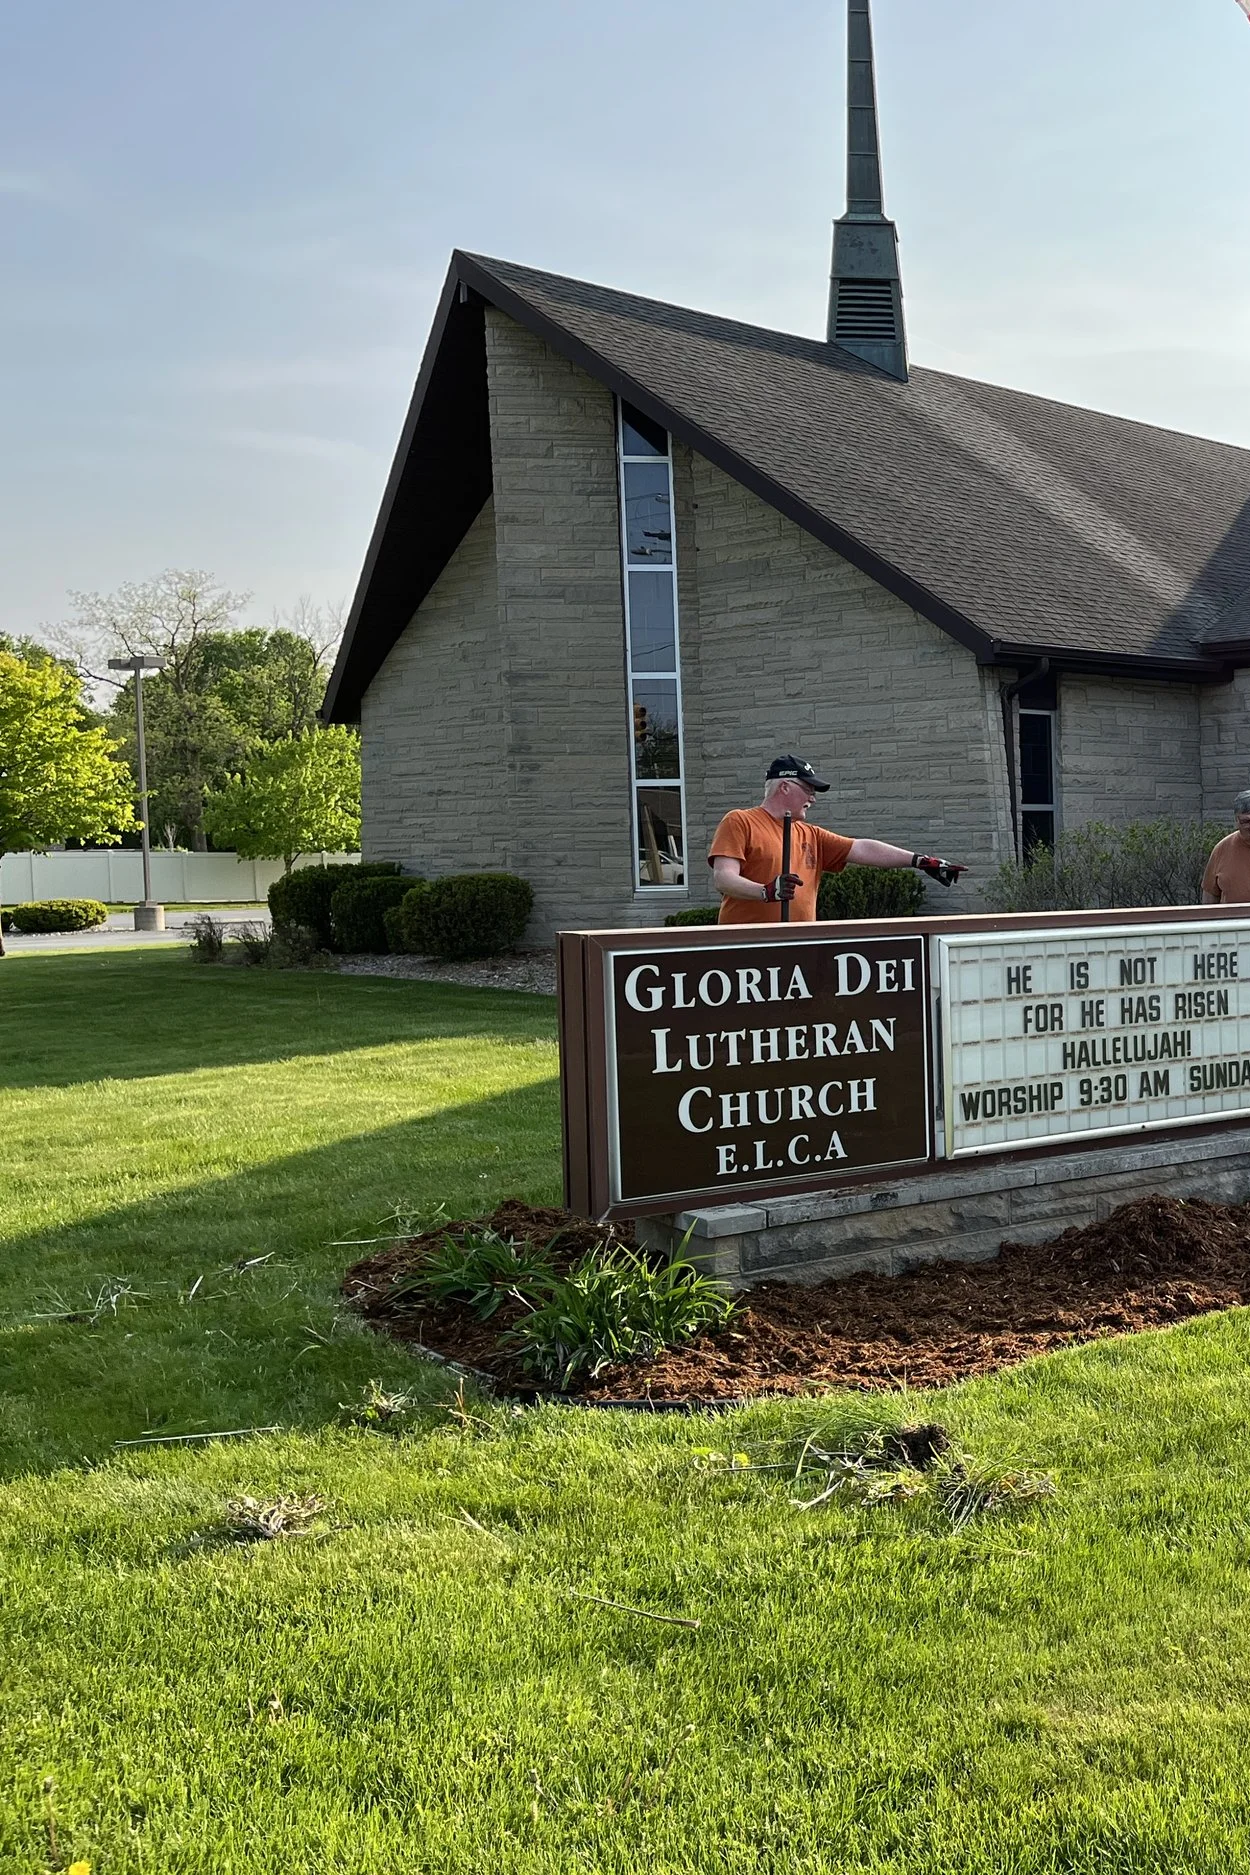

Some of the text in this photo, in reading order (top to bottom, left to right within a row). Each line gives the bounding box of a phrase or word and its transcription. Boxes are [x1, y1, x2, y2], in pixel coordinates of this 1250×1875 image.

[625, 952, 916, 1012] GLORIA DEI
[1007, 951, 1238, 995] HE IS NOT HERE
[1023, 989, 1229, 1033] FOR HE HAS RISEN
[651, 1017, 896, 1074] LUTHERAN
[1062, 1030, 1191, 1069] HALLELUJAH!
[678, 1077, 877, 1133] CHURCH
[961, 1081, 1063, 1121] WORSHIP
[1079, 1074, 1127, 1106] 9:30
[1139, 1069, 1170, 1098] AM
[716, 1130, 848, 1175] E.L.C.A
